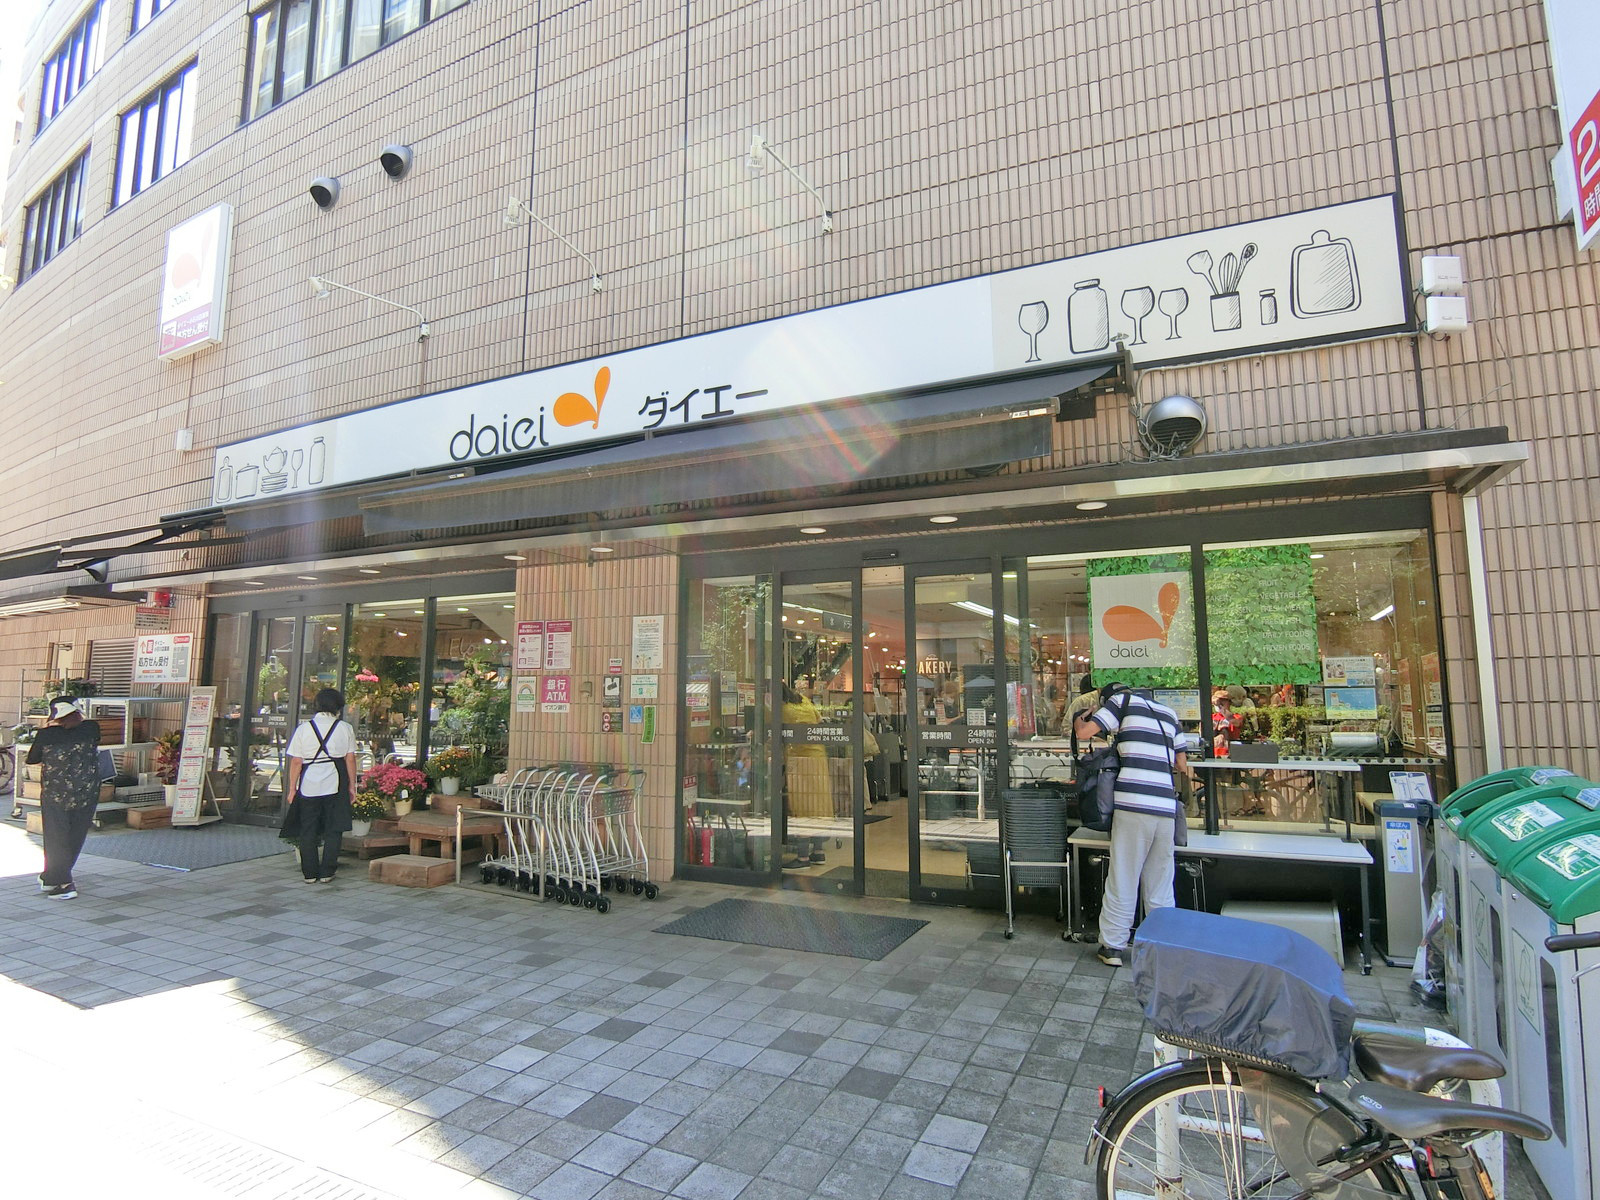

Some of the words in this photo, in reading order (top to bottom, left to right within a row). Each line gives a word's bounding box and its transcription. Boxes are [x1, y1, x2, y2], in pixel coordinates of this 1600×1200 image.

[1577, 119, 1600, 189] 2
[638, 384, 769, 430] ダイエー
[449, 406, 549, 461] daiei
[1258, 579, 1278, 587] FRUIT
[1260, 591, 1303, 600] VEGETABLE
[1285, 630, 1311, 638] FOODS
[1109, 644, 1149, 658] daiei
[1288, 643, 1311, 651] FOODS
[138, 656, 169, 667] 処方せん受付
[918, 661, 952, 674] AKERY
[547, 679, 567, 690] 銀行
[546, 691, 567, 701] ATM
[806, 727, 844, 736] 24時間営業
[921, 731, 952, 740] 営業時間
[1359, 1094, 1383, 1110] NESTO
